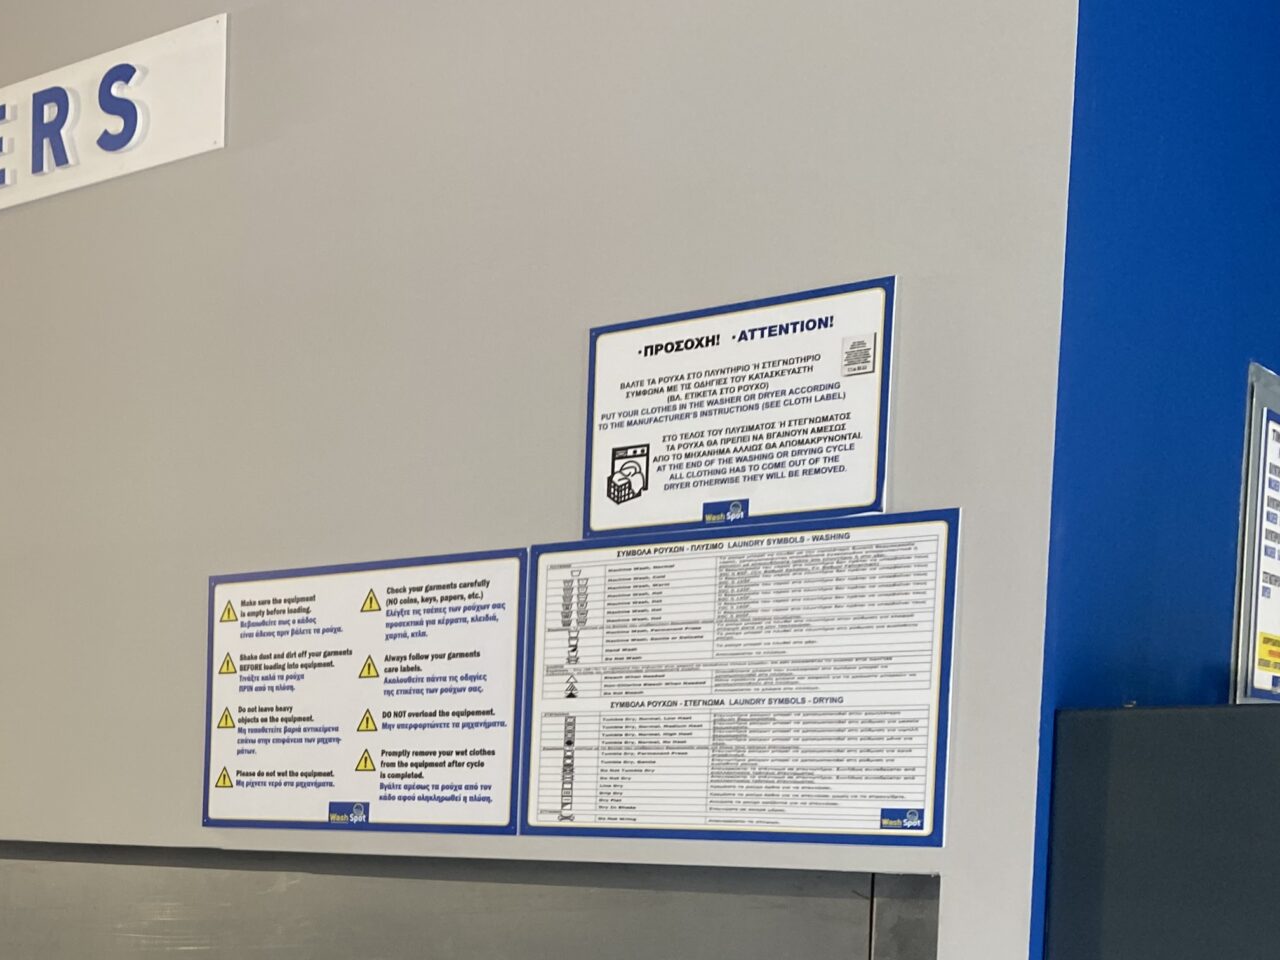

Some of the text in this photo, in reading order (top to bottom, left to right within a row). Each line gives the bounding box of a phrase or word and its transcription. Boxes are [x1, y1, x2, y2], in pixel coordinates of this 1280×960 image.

[737, 315, 834, 342] ATTENTION!
[644, 334, 720, 357] ΠΡΟΣΟΧΗ!
[598, 392, 846, 431] TO THE MANUFACTURER'S INSTRUCTIONS (SEE CLOTH LABEL)
[600, 412, 616, 421] PUT
[617, 409, 639, 418] YOUR
[640, 404, 678, 416] CLOTHES
[689, 400, 704, 409] THE
[706, 395, 742, 406] WASHER
[743, 393, 756, 402] OR
[758, 389, 786, 400] DRYER
[788, 382, 841, 396] ACCORDING
